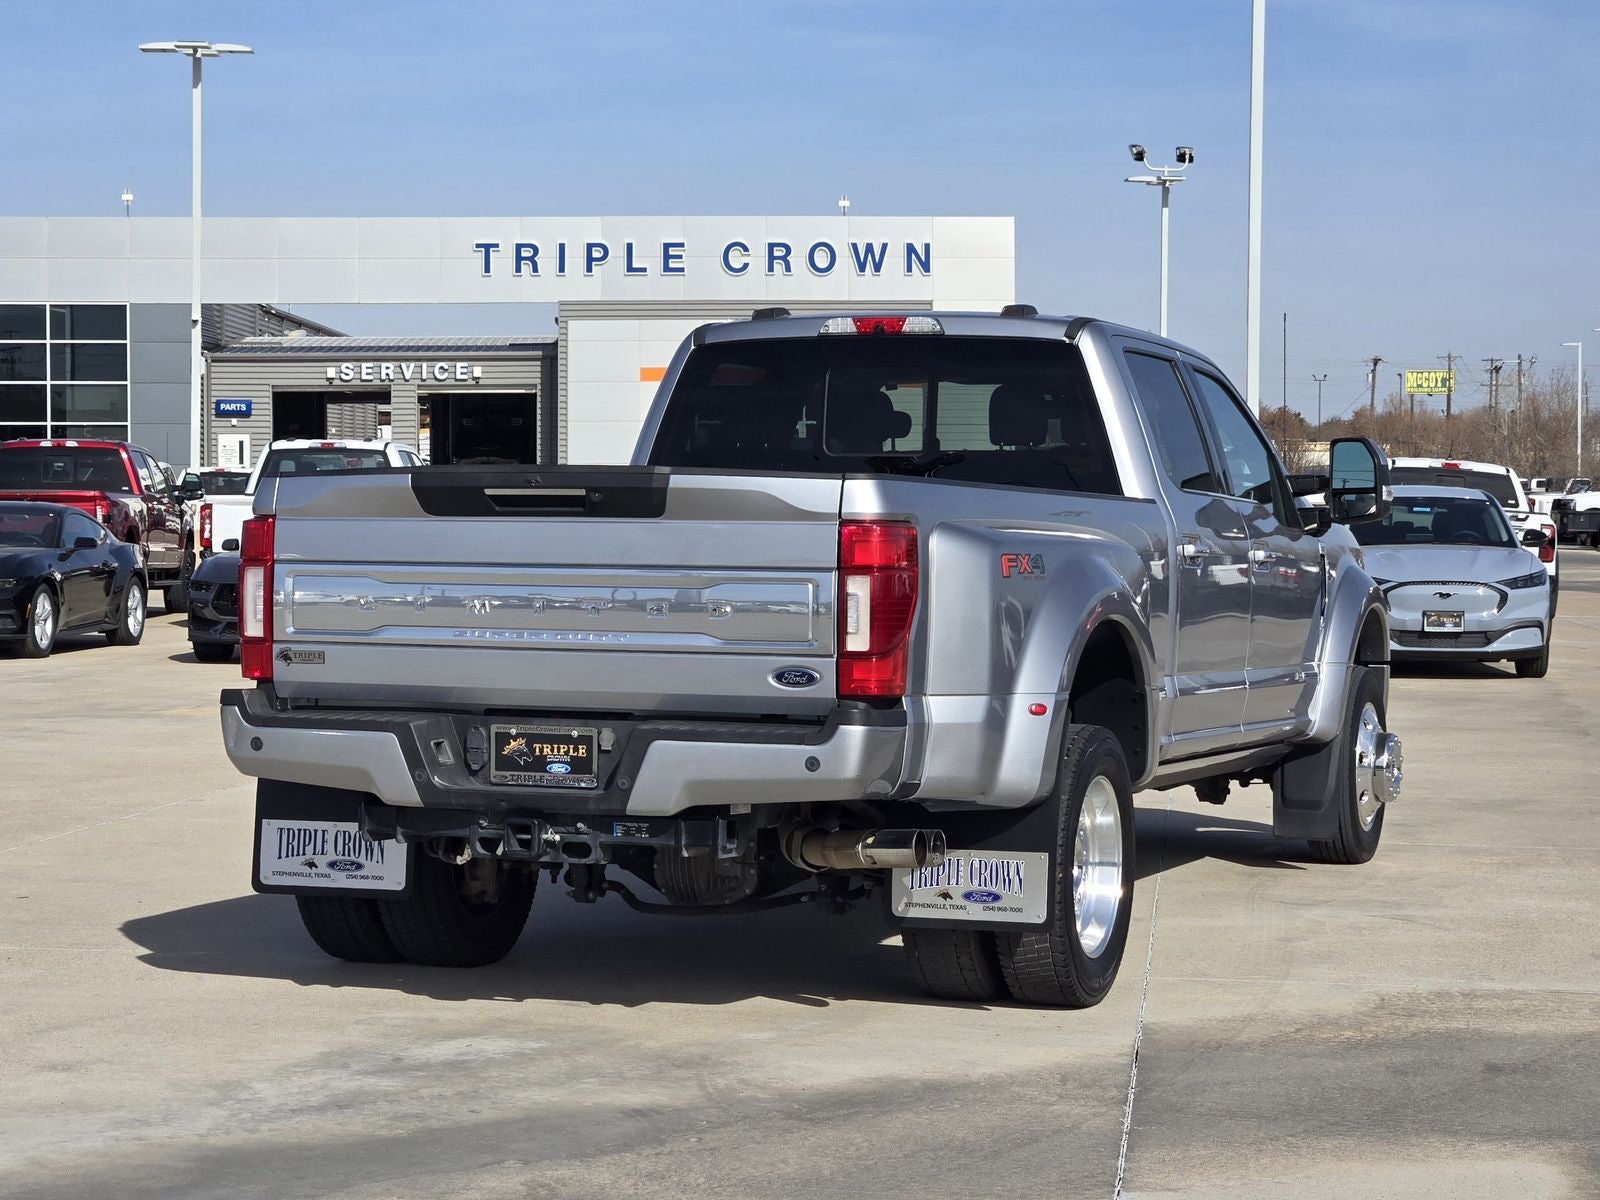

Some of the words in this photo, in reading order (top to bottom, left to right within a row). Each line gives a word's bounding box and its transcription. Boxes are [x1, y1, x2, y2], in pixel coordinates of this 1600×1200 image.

[474, 242, 686, 275] TRIPLE
[721, 241, 932, 275] CROWN
[339, 362, 470, 381] SERVICE
[220, 403, 247, 411] PARTS
[1000, 554, 1045, 578] FX4
[782, 671, 808, 684] Ford
[533, 743, 587, 757] TRIPLE
[277, 827, 328, 860] TRIPLE
[334, 829, 385, 866] CROWN
[333, 861, 357, 871] Ford
[969, 858, 1025, 897] CROWN
[970, 892, 994, 902] Ford
